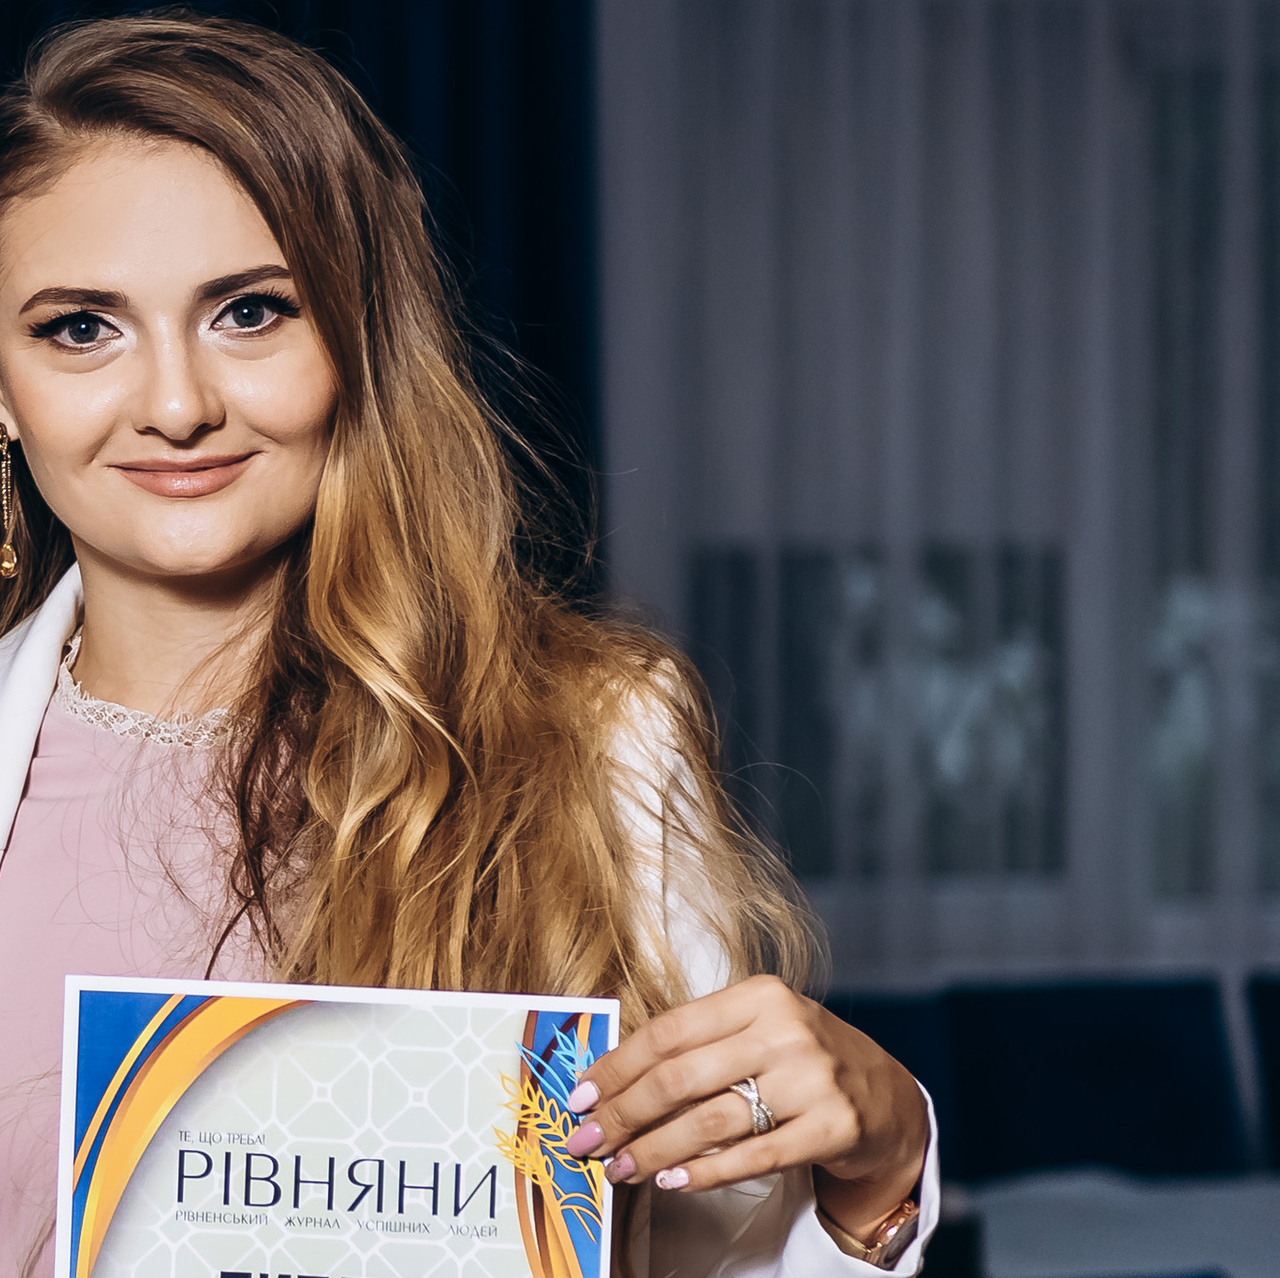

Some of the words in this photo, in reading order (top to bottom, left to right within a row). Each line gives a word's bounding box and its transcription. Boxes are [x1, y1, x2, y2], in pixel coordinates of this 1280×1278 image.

[177, 1130, 194, 1144] ТЕ,
[198, 1132, 222, 1146] ЩО
[226, 1132, 266, 1146] ТРЕБА!
[176, 1148, 498, 1219] РІВНЯНИ
[174, 1209, 269, 1227] РІВНЕНСЬКИЙ
[284, 1215, 341, 1229] ЖУРНАЛ
[356, 1218, 431, 1234] УСПІШНИХ
[446, 1224, 498, 1239] ЛЮДЕЙ
